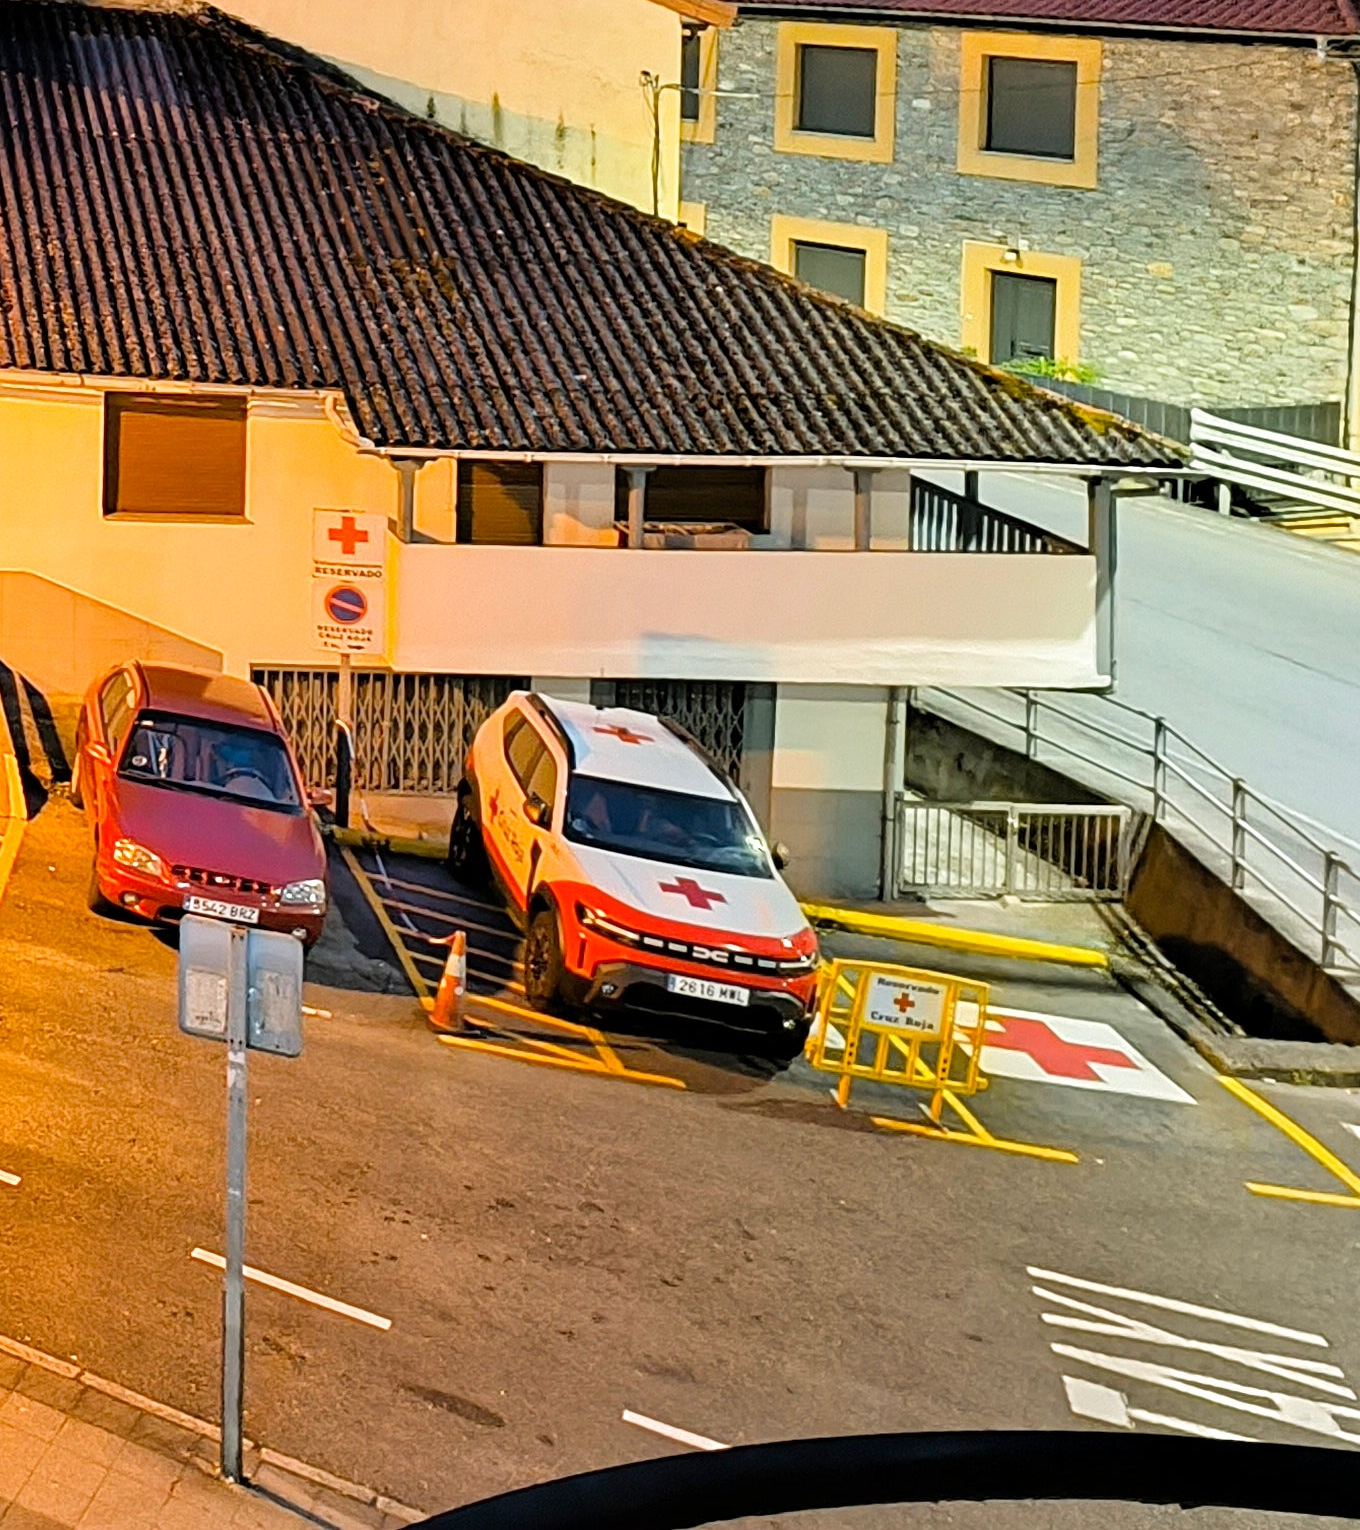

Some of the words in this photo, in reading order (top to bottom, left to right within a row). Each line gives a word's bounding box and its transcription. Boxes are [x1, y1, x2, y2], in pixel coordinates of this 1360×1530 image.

[314, 567, 382, 578] RESERVADO
[678, 978, 716, 997] 2616
[876, 977, 940, 995] Reservado
[870, 1010, 900, 1024] Cruz
[905, 1016, 935, 1031] Roja
